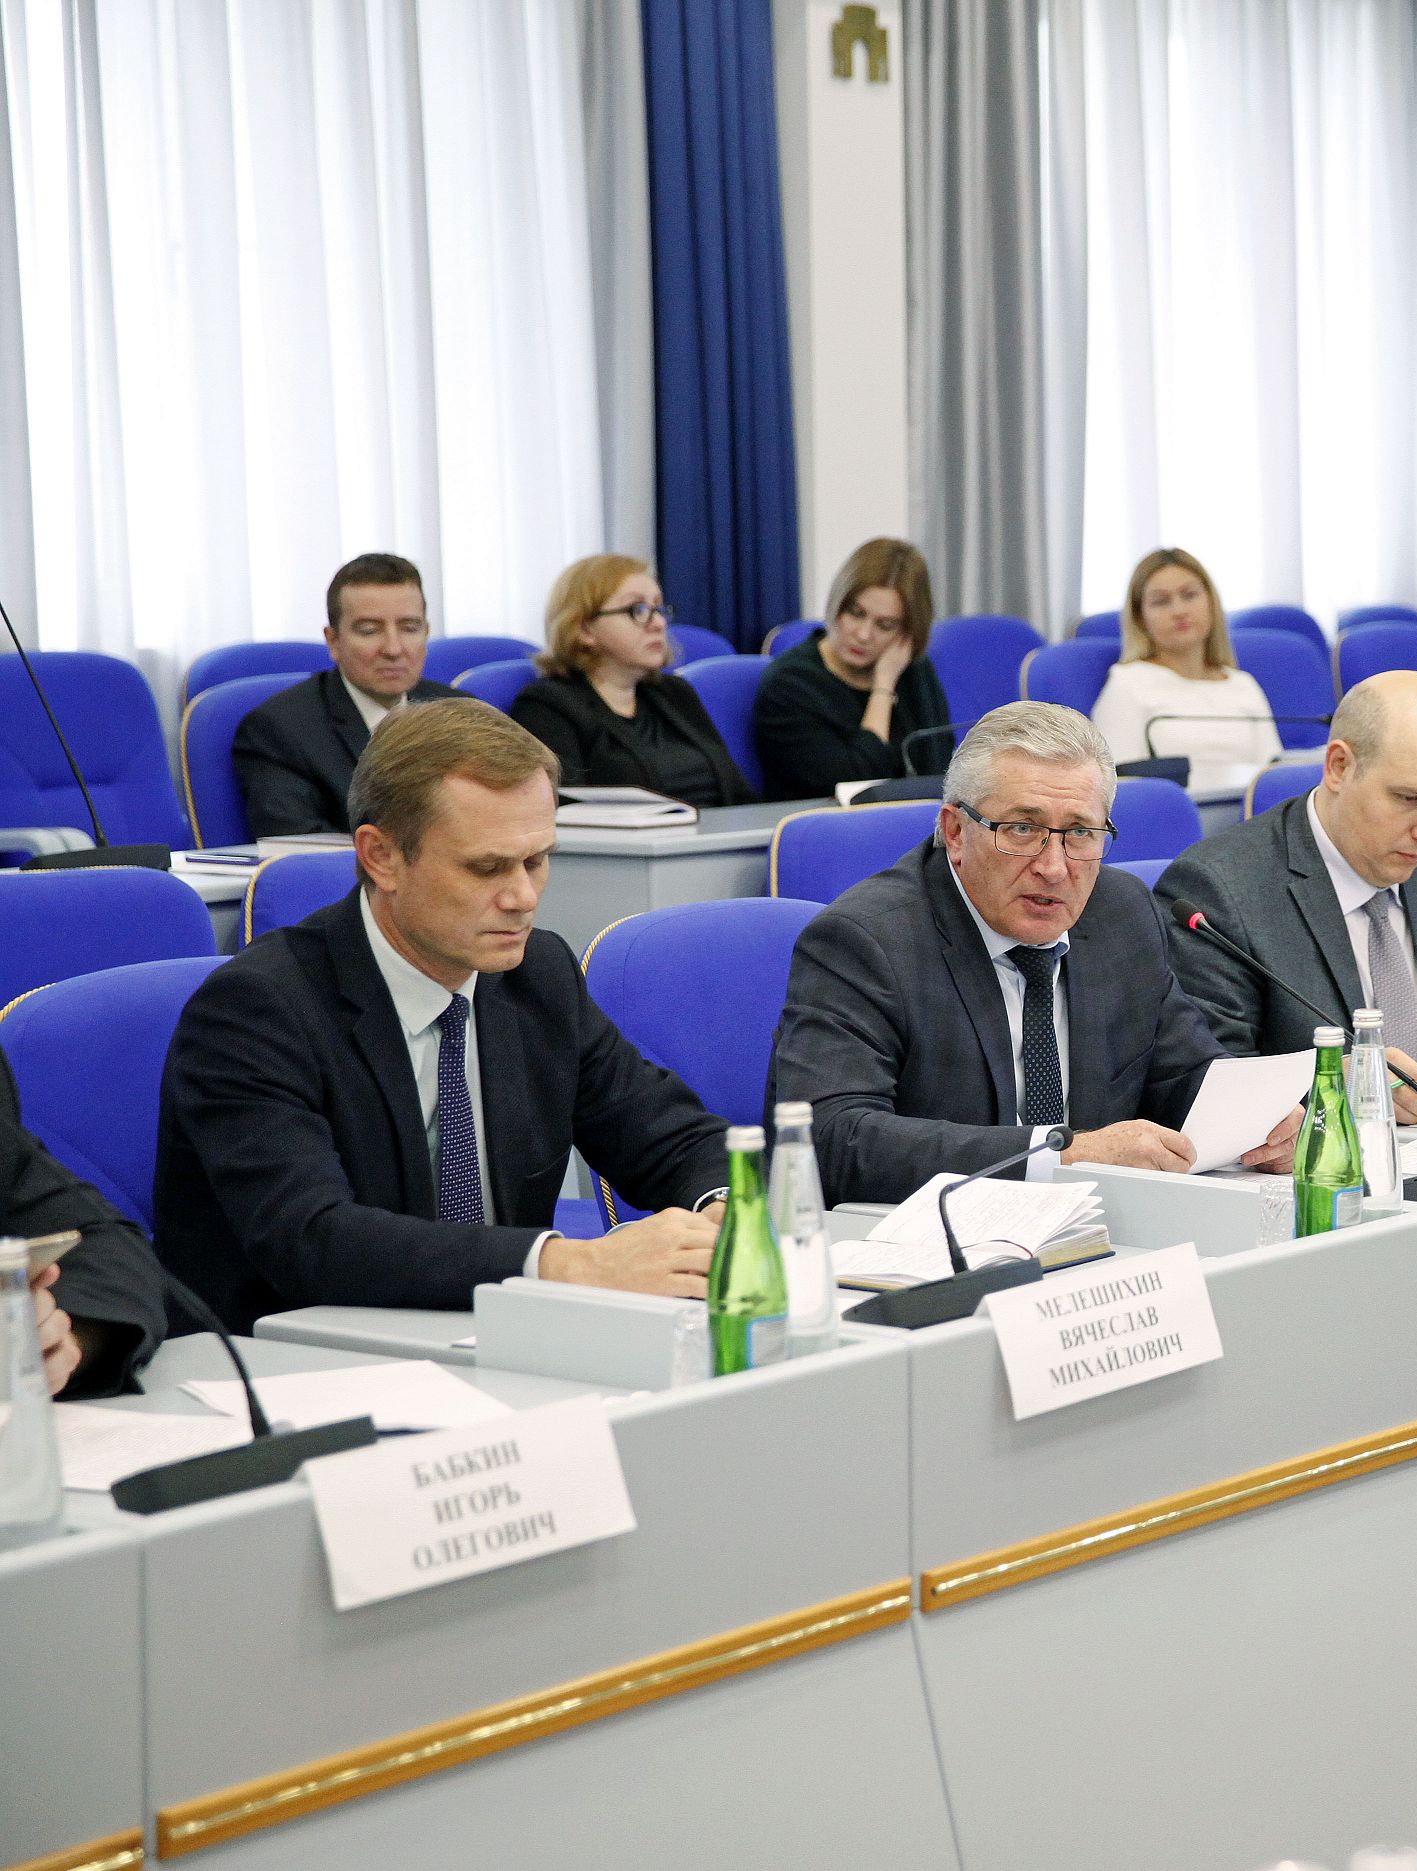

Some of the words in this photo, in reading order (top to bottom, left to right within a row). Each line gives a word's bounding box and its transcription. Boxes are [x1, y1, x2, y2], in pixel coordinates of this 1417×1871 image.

[1036, 1270, 1163, 1321] МЕЛЕШИХИН
[1059, 1306, 1160, 1351] ВЯЧЕСЛАВ
[1049, 1332, 1184, 1388] МИХАЙЛОВИЧ
[411, 1440, 521, 1489] БАБКИН
[432, 1482, 521, 1525] ИГОРЬ
[413, 1511, 557, 1570] ОЛЕГОВИЧ
